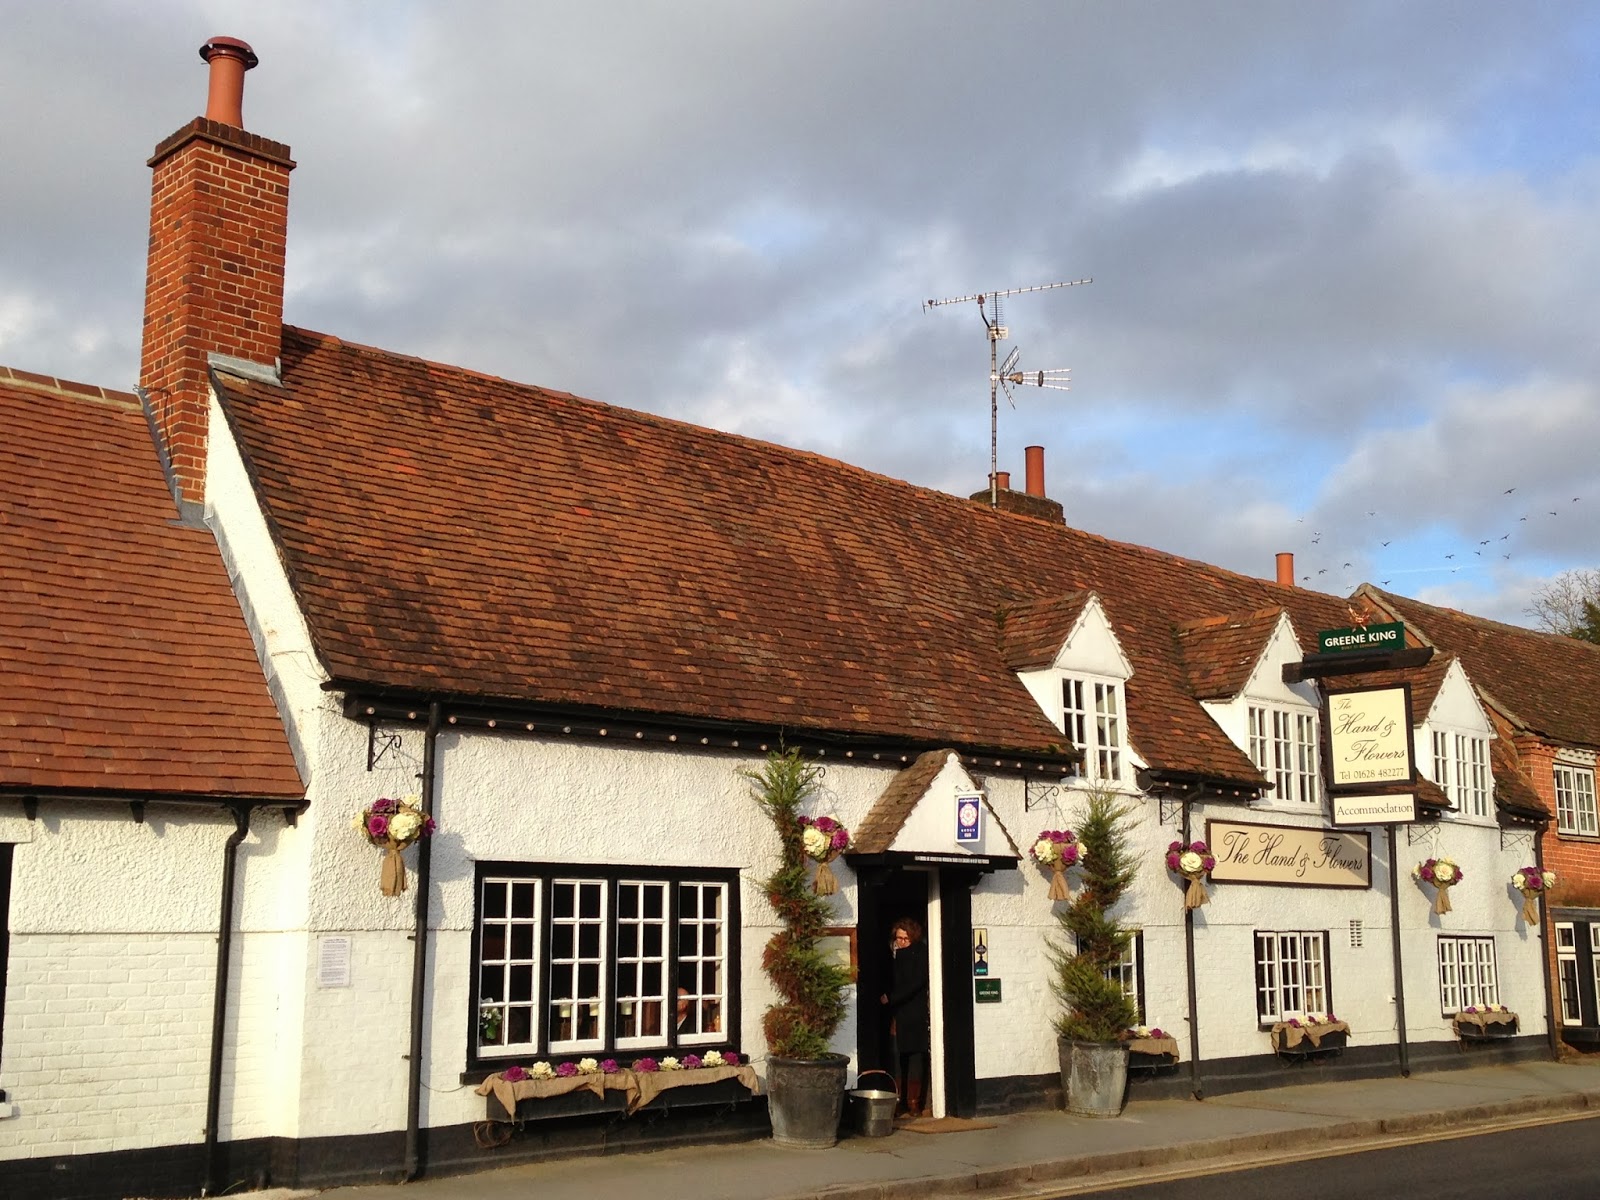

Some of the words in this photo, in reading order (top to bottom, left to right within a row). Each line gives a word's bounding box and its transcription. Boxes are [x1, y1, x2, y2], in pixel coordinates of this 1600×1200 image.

[1324, 633, 1366, 648] GREENE
[1368, 630, 1397, 643] KING
[1334, 698, 1352, 710] The
[1333, 712, 1386, 735] Hand
[1380, 720, 1397, 738] &
[1344, 739, 1405, 762] Flowers
[1340, 771, 1351, 780] Tel
[1353, 769, 1376, 779] 01628
[1378, 767, 1405, 778] 482277
[1336, 802, 1413, 816] Accommodation
[1218, 830, 1251, 864] The
[1253, 832, 1301, 867] Hand
[1295, 852, 1311, 878] &
[1313, 837, 1363, 871] Flowers
